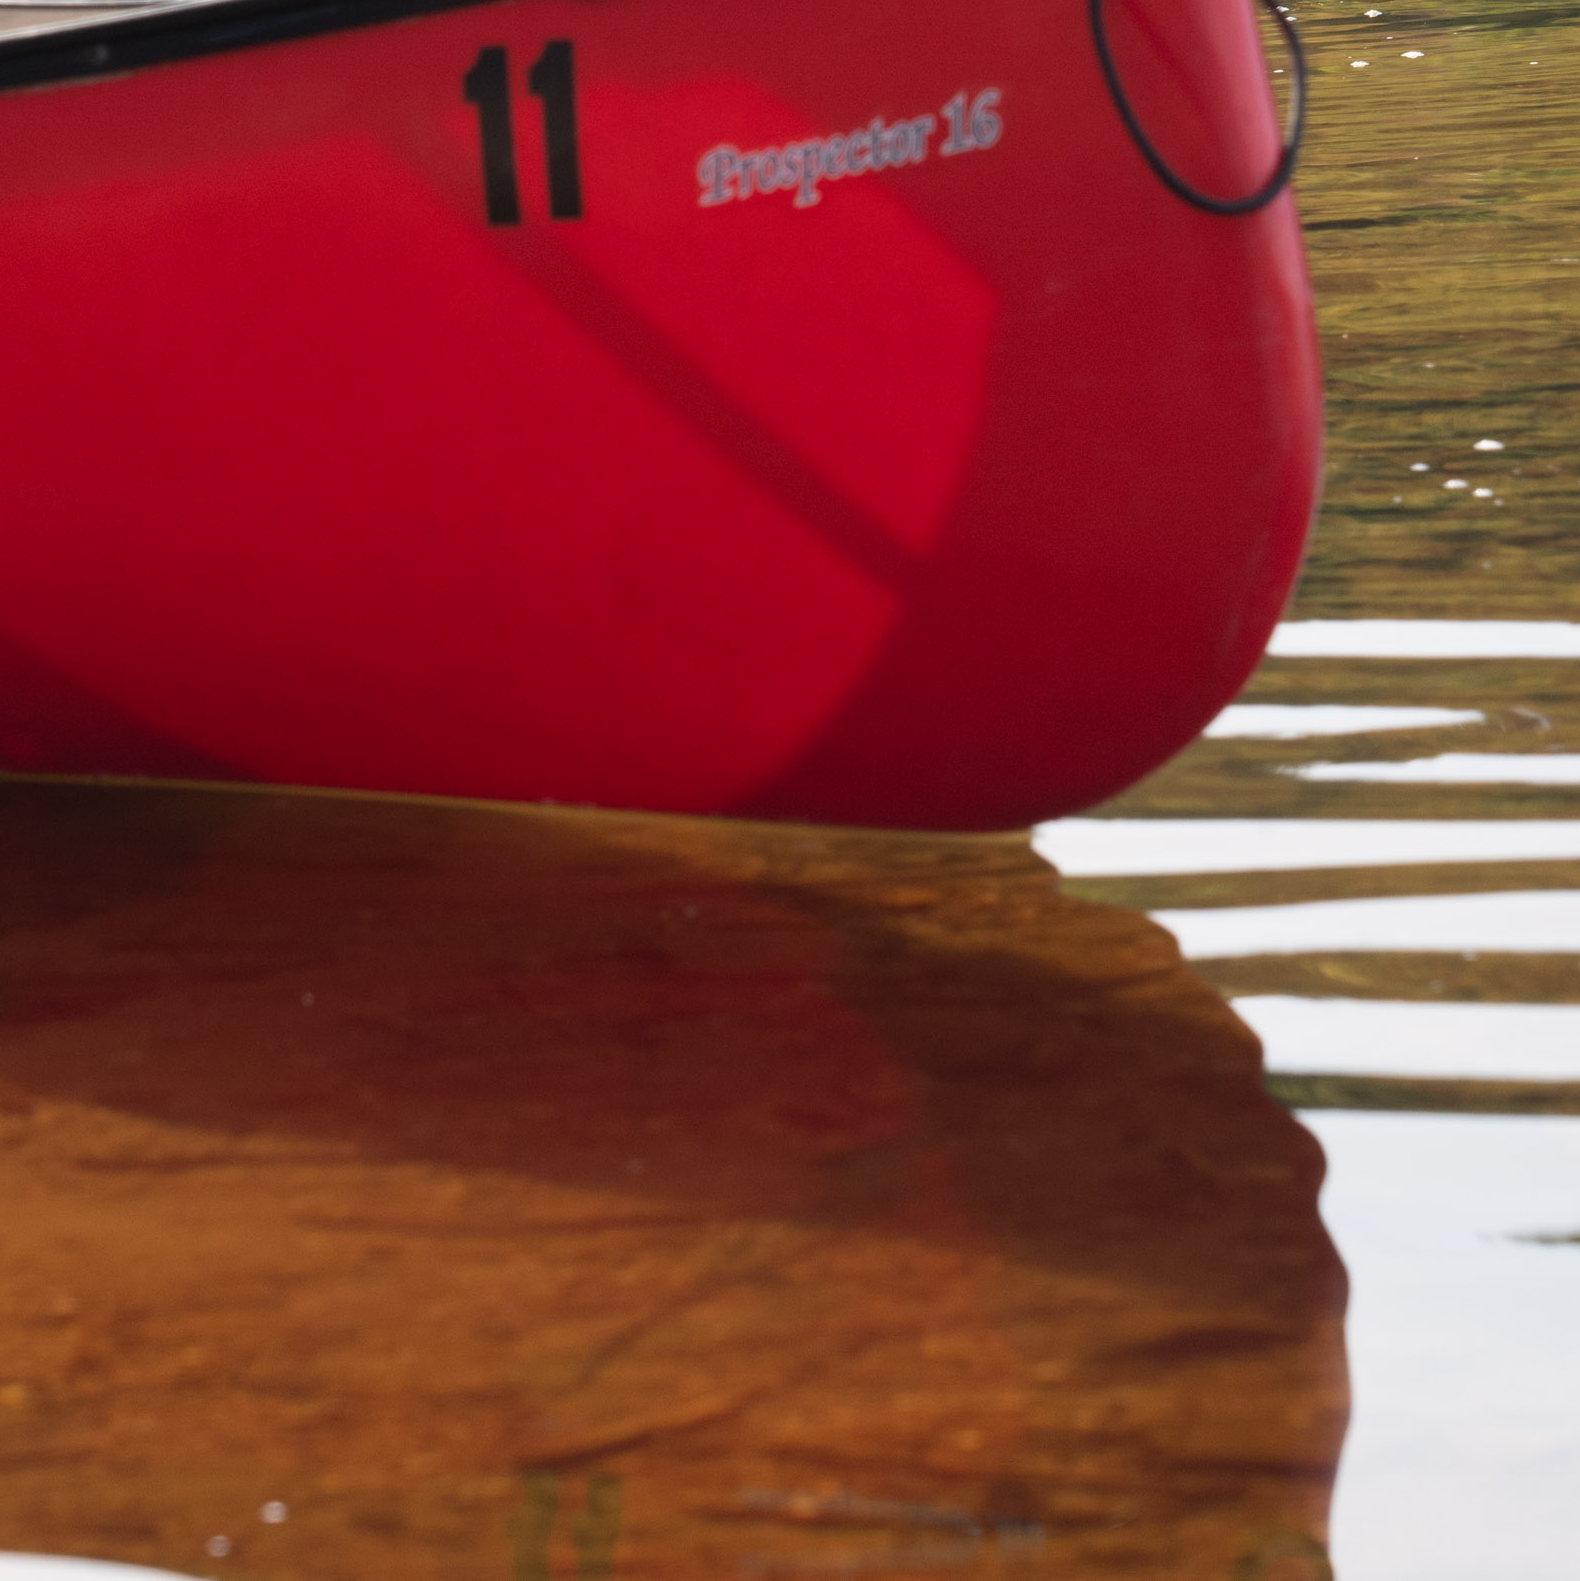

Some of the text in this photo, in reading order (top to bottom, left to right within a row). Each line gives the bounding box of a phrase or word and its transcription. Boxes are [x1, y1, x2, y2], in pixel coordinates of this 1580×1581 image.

[463, 40, 583, 226] 11
[697, 86, 1003, 208] Prospector 16
